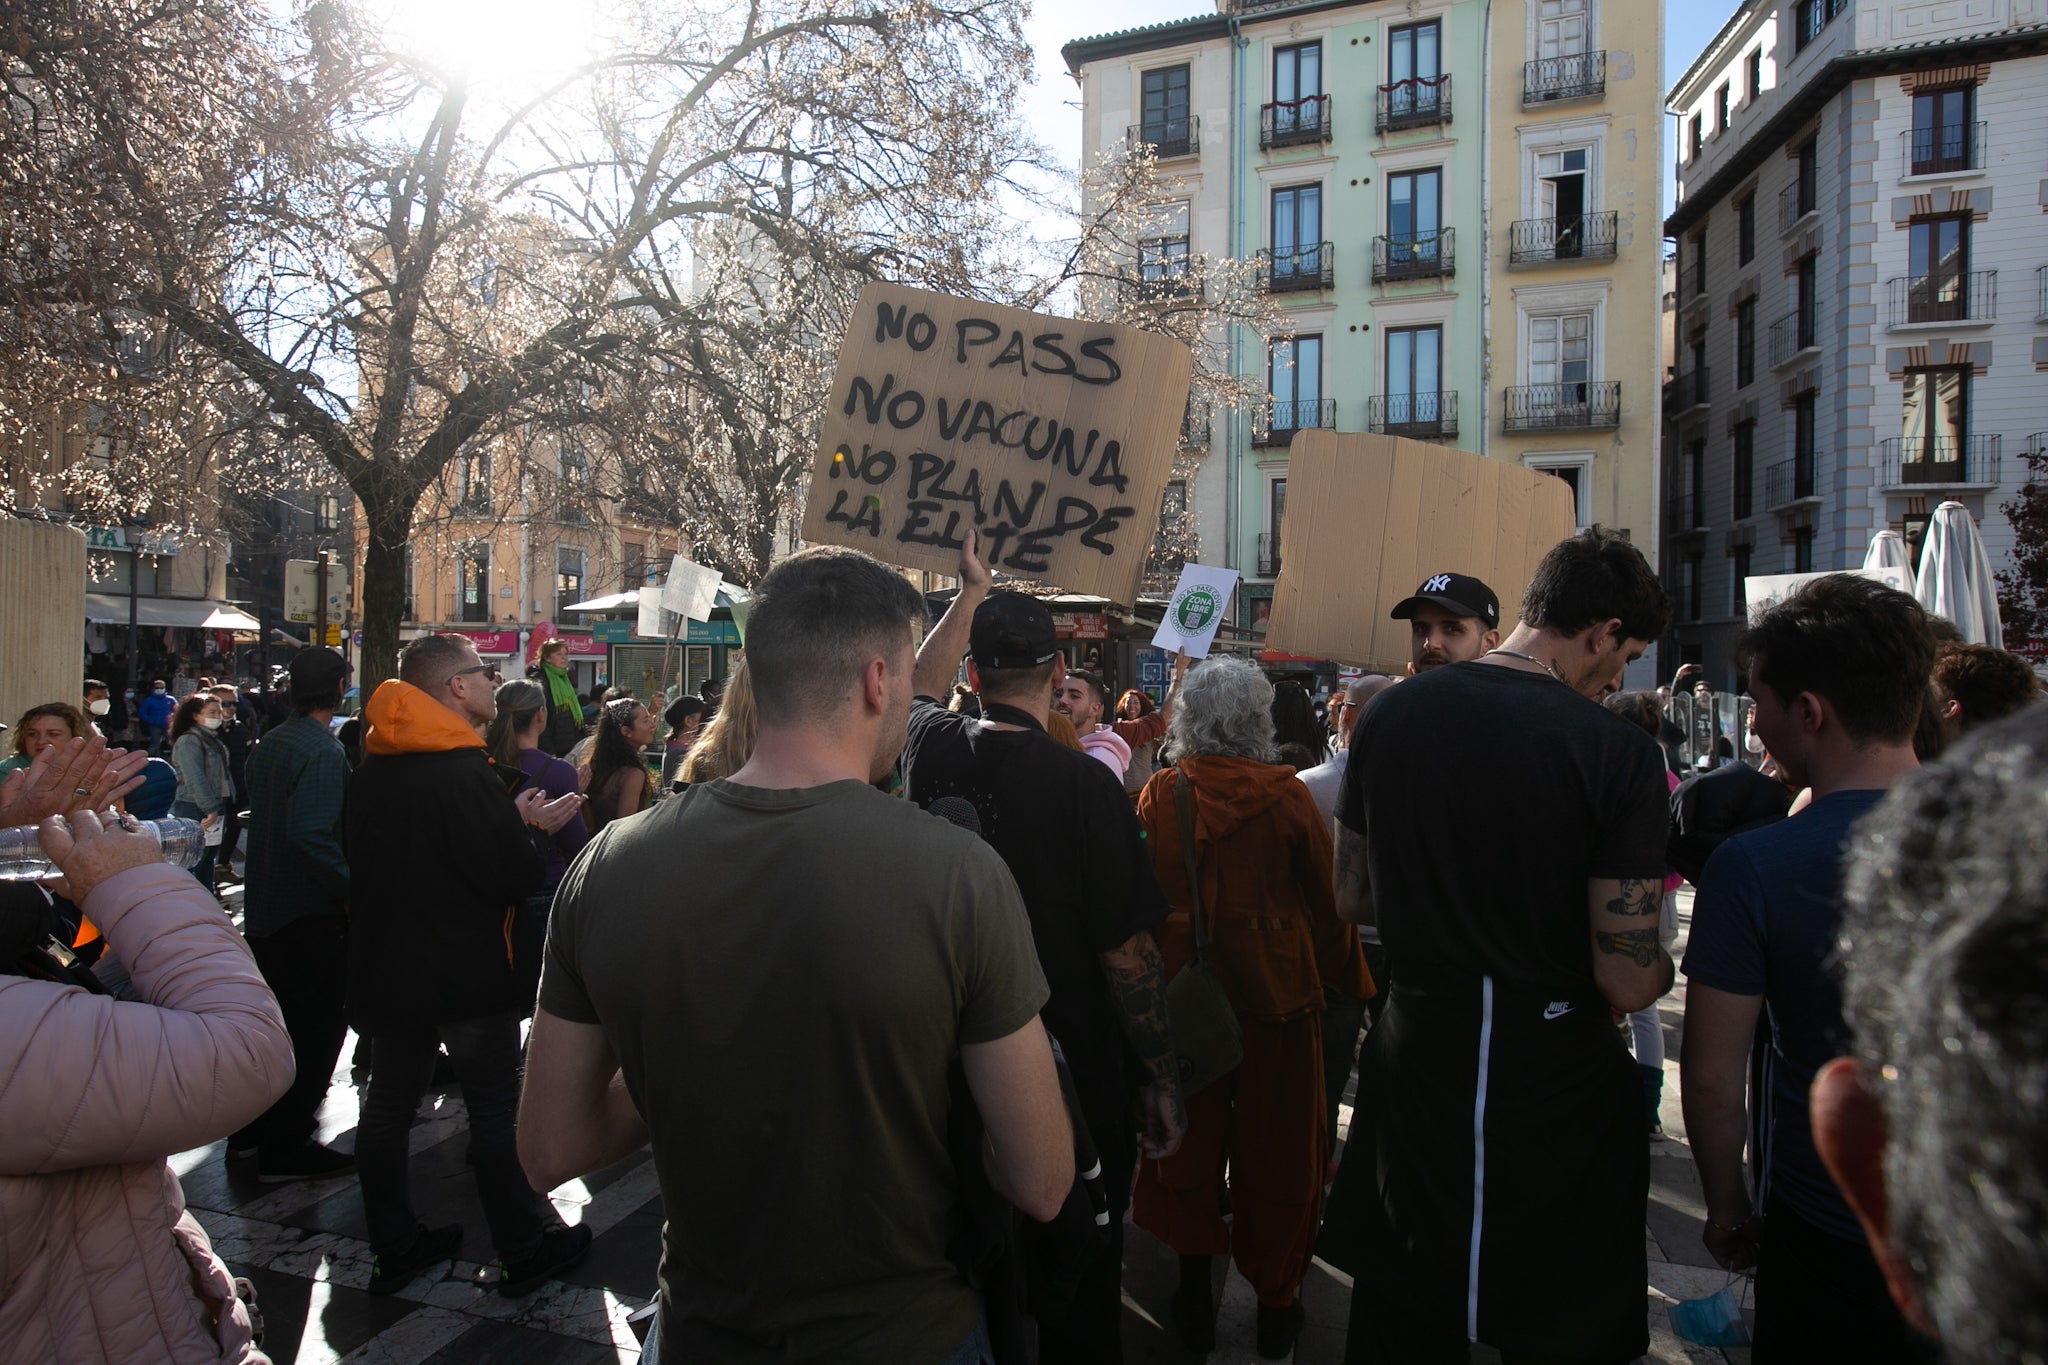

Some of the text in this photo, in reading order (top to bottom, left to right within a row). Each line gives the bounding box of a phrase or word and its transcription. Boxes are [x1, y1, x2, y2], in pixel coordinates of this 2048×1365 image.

[875, 301, 1121, 386] NO PASS
[843, 373, 1129, 494] NO VACUNA
[828, 443, 1135, 556] NO PLAN DE
[825, 490, 882, 537] LA
[1423, 574, 1452, 592] NY
[1175, 585, 1222, 611] NO AL PASE COVID
[1185, 603, 1211, 614] LIBRE
[1188, 595, 1212, 606] ZONA
[1171, 607, 1218, 636] INCONSTITUCIONAL
[1547, 1001, 1570, 1012] NIKE
